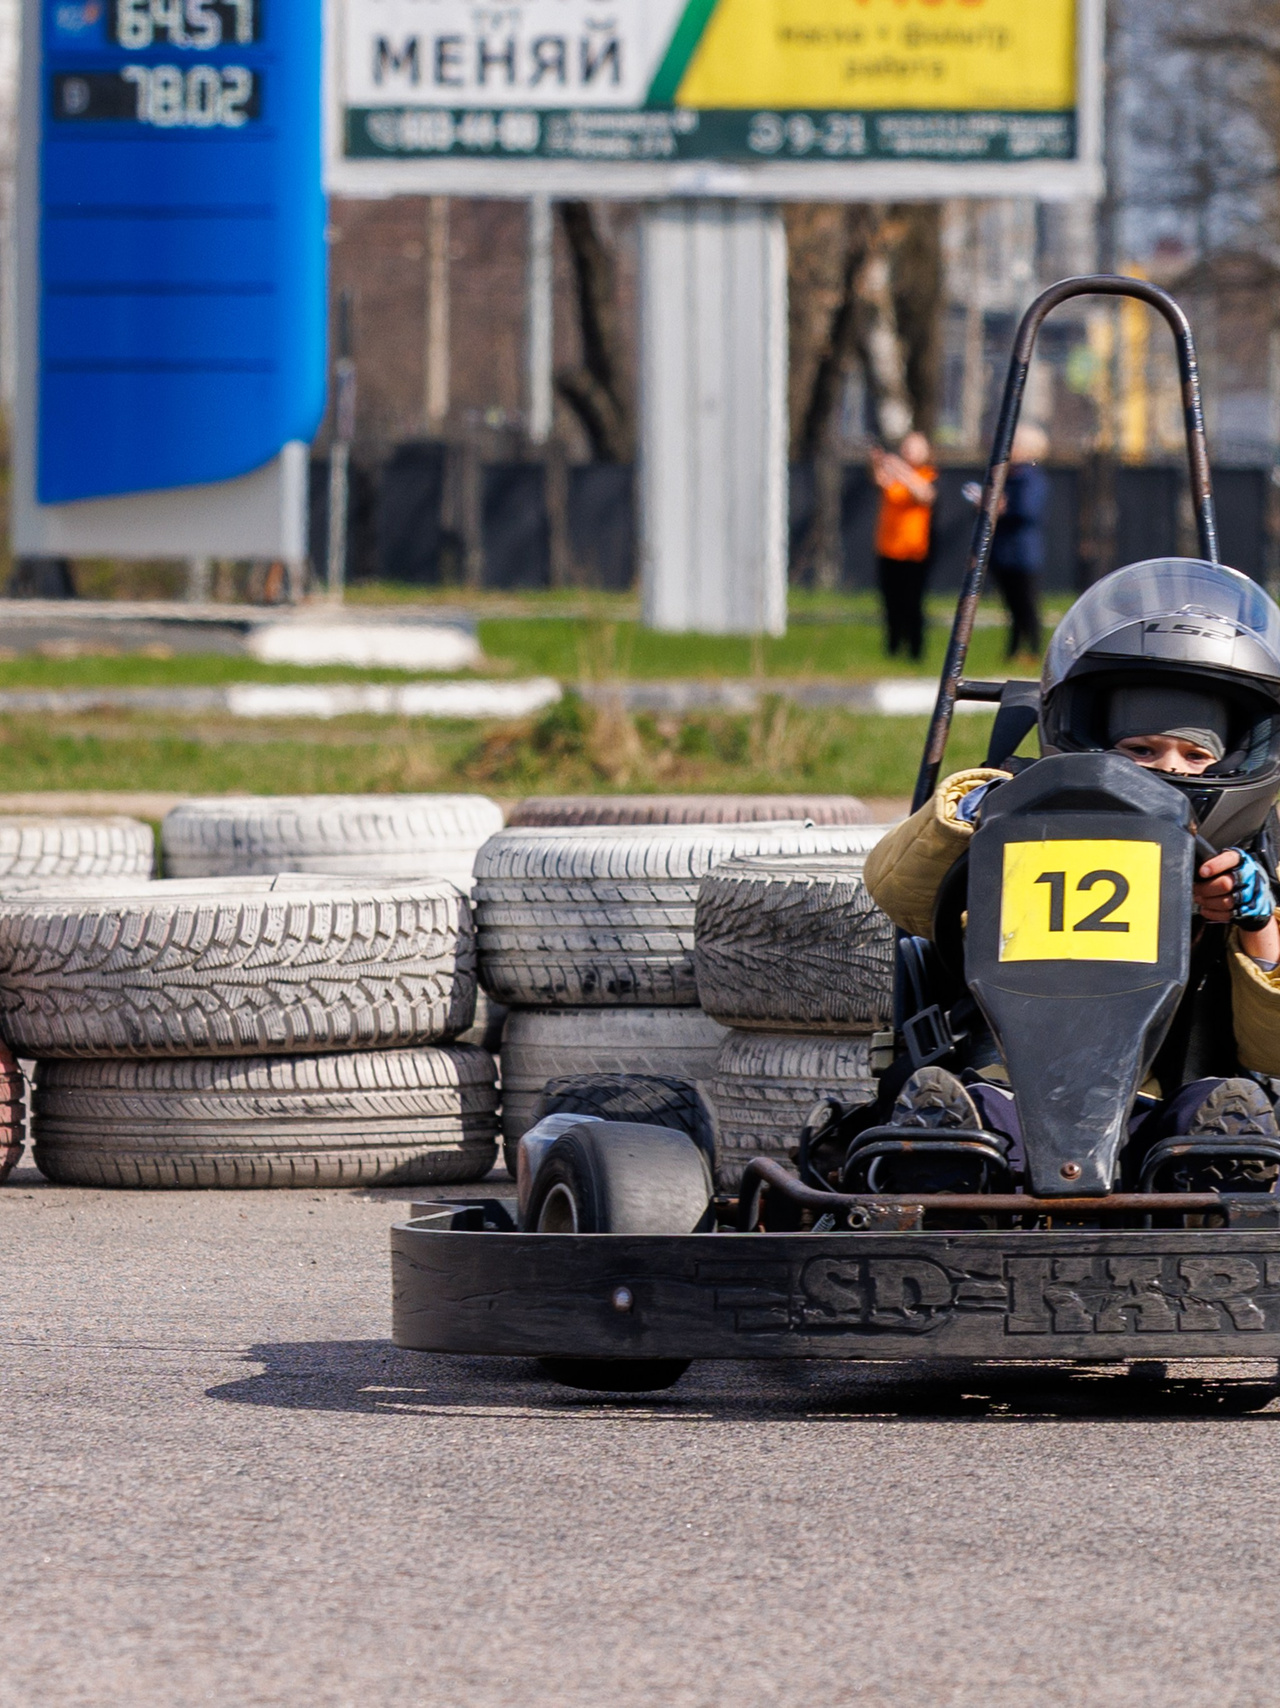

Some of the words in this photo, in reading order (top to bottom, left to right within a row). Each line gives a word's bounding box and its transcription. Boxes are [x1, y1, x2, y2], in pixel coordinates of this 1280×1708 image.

[372, 17, 620, 87] МЕНЯЙ
[1144, 623, 1234, 643] LS2
[1034, 869, 1130, 932] 12
